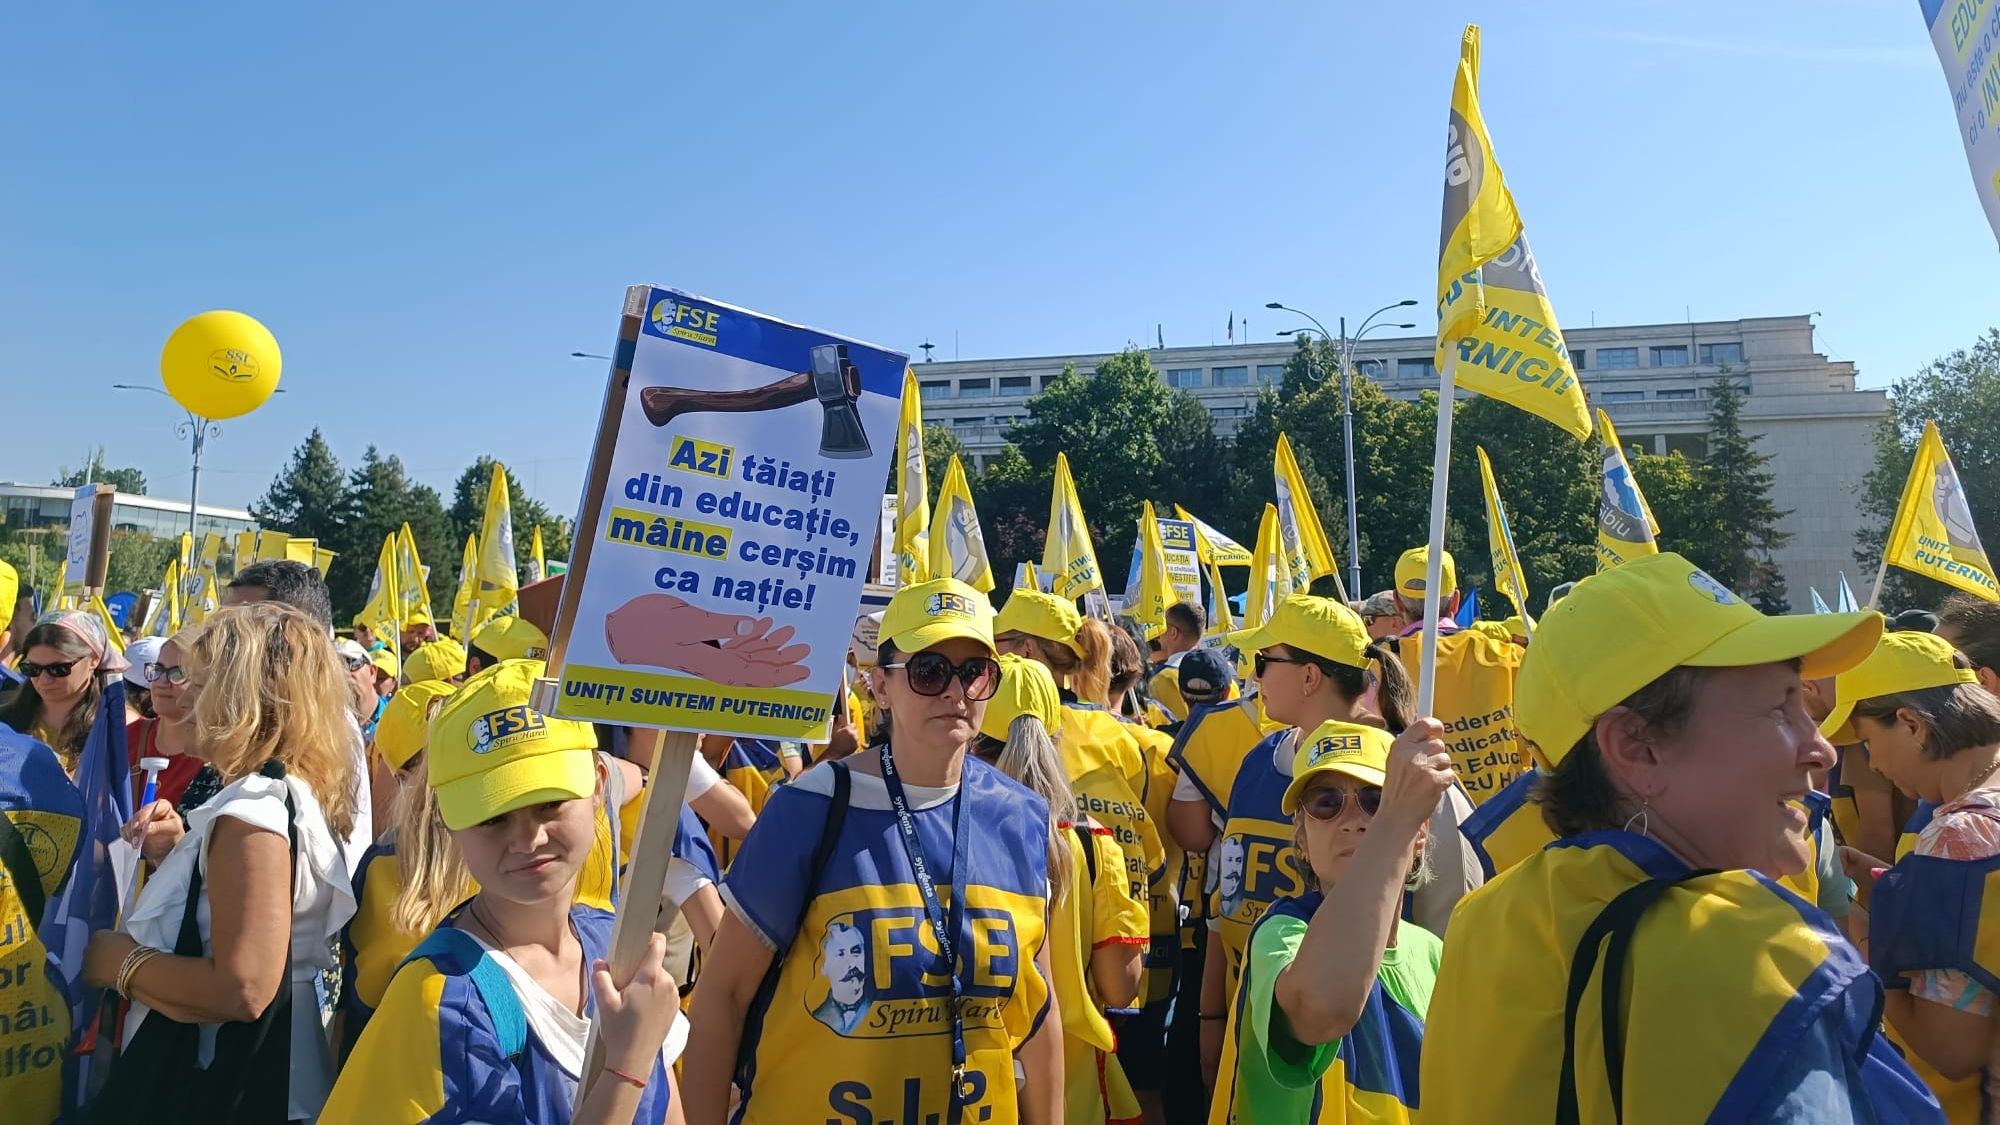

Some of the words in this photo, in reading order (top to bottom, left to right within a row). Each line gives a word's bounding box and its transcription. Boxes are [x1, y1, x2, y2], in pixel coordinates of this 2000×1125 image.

[1967, 46, 1985, 88] este
[676, 304, 720, 332] FSE
[1457, 336, 1575, 396] RNICI!
[671, 439, 731, 476] Azi
[742, 455, 836, 503] tăiați
[625, 473, 683, 508] din
[696, 491, 859, 547] educație,
[610, 517, 727, 557] mâine
[739, 540, 857, 580] cerșim
[1166, 524, 1189, 539] FSE
[654, 567, 700, 593] ca
[712, 576, 816, 614] nație!
[942, 594, 975, 615] FSE
[489, 707, 544, 737] FSE
[565, 680, 624, 705] UNIȚI
[630, 687, 716, 711] SUNTEM
[720, 698, 826, 722] PUTERNICI!
[1319, 736, 1360, 754] FSE
[895, 795, 913, 835] syngenta
[915, 856, 933, 898] syngenta
[1245, 841, 1305, 899] FS
[1242, 901, 1265, 924] Sp
[870, 916, 1013, 990] FSE
[869, 1001, 941, 1034] Spiru
